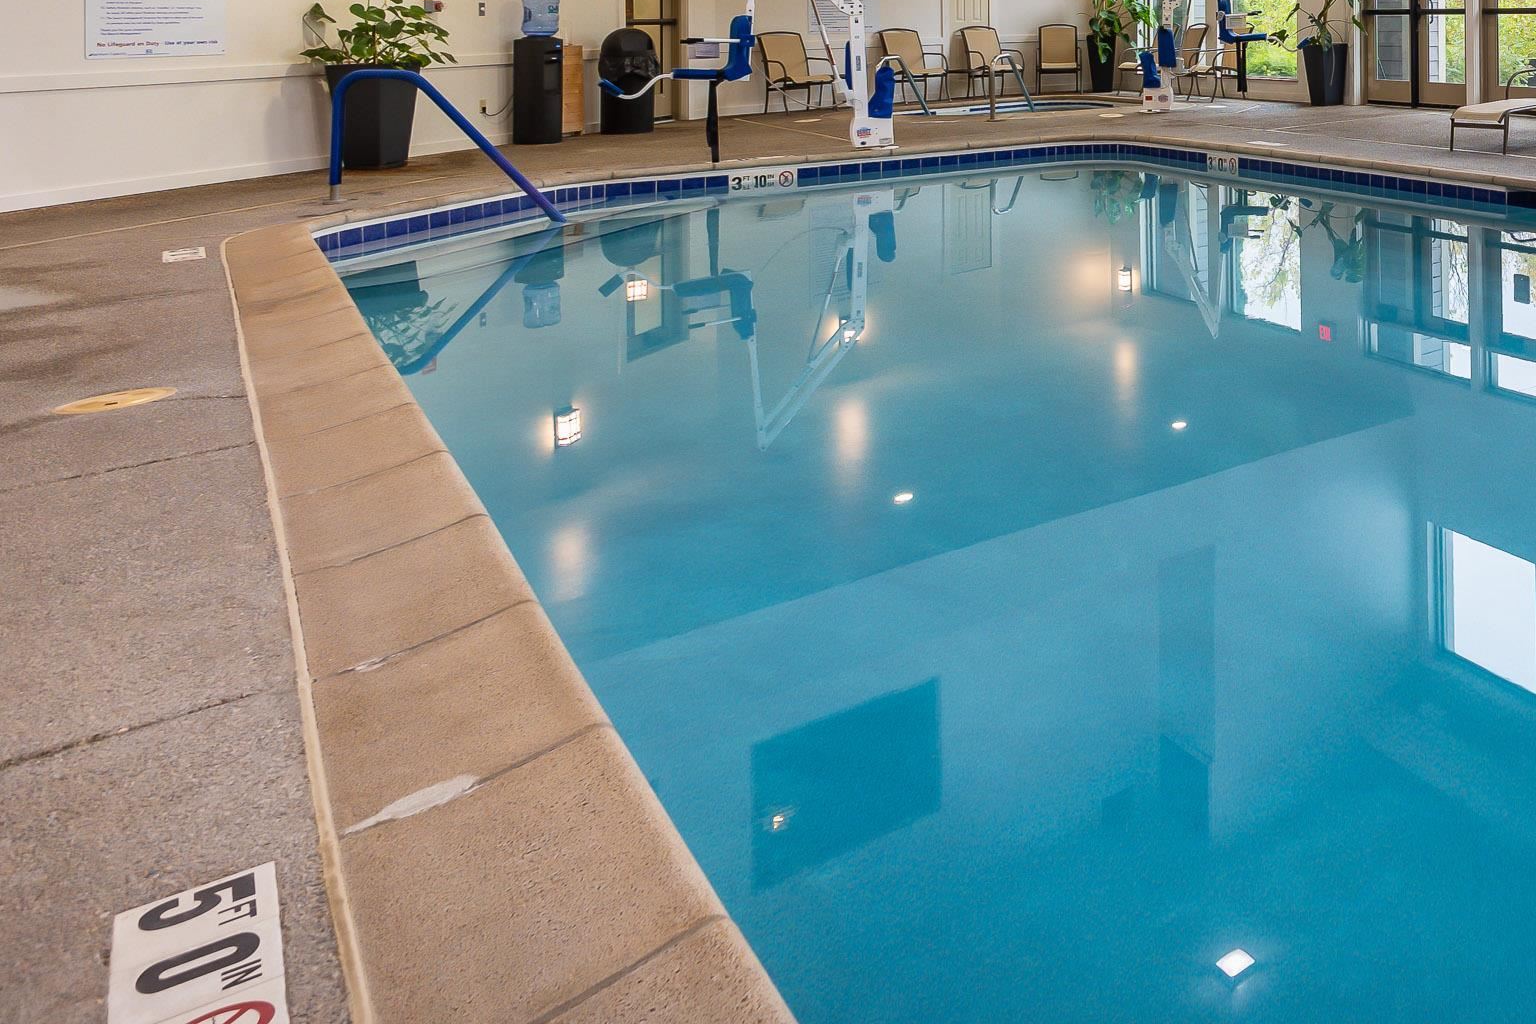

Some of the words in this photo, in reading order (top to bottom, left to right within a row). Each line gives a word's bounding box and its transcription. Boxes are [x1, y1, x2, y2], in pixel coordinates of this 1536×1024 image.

[731, 177, 742, 190] 3
[753, 175, 767, 188] 10
[138, 872, 256, 932] 5
[218, 898, 257, 926] FT
[135, 932, 260, 994] 0
[221, 958, 262, 991] IN
